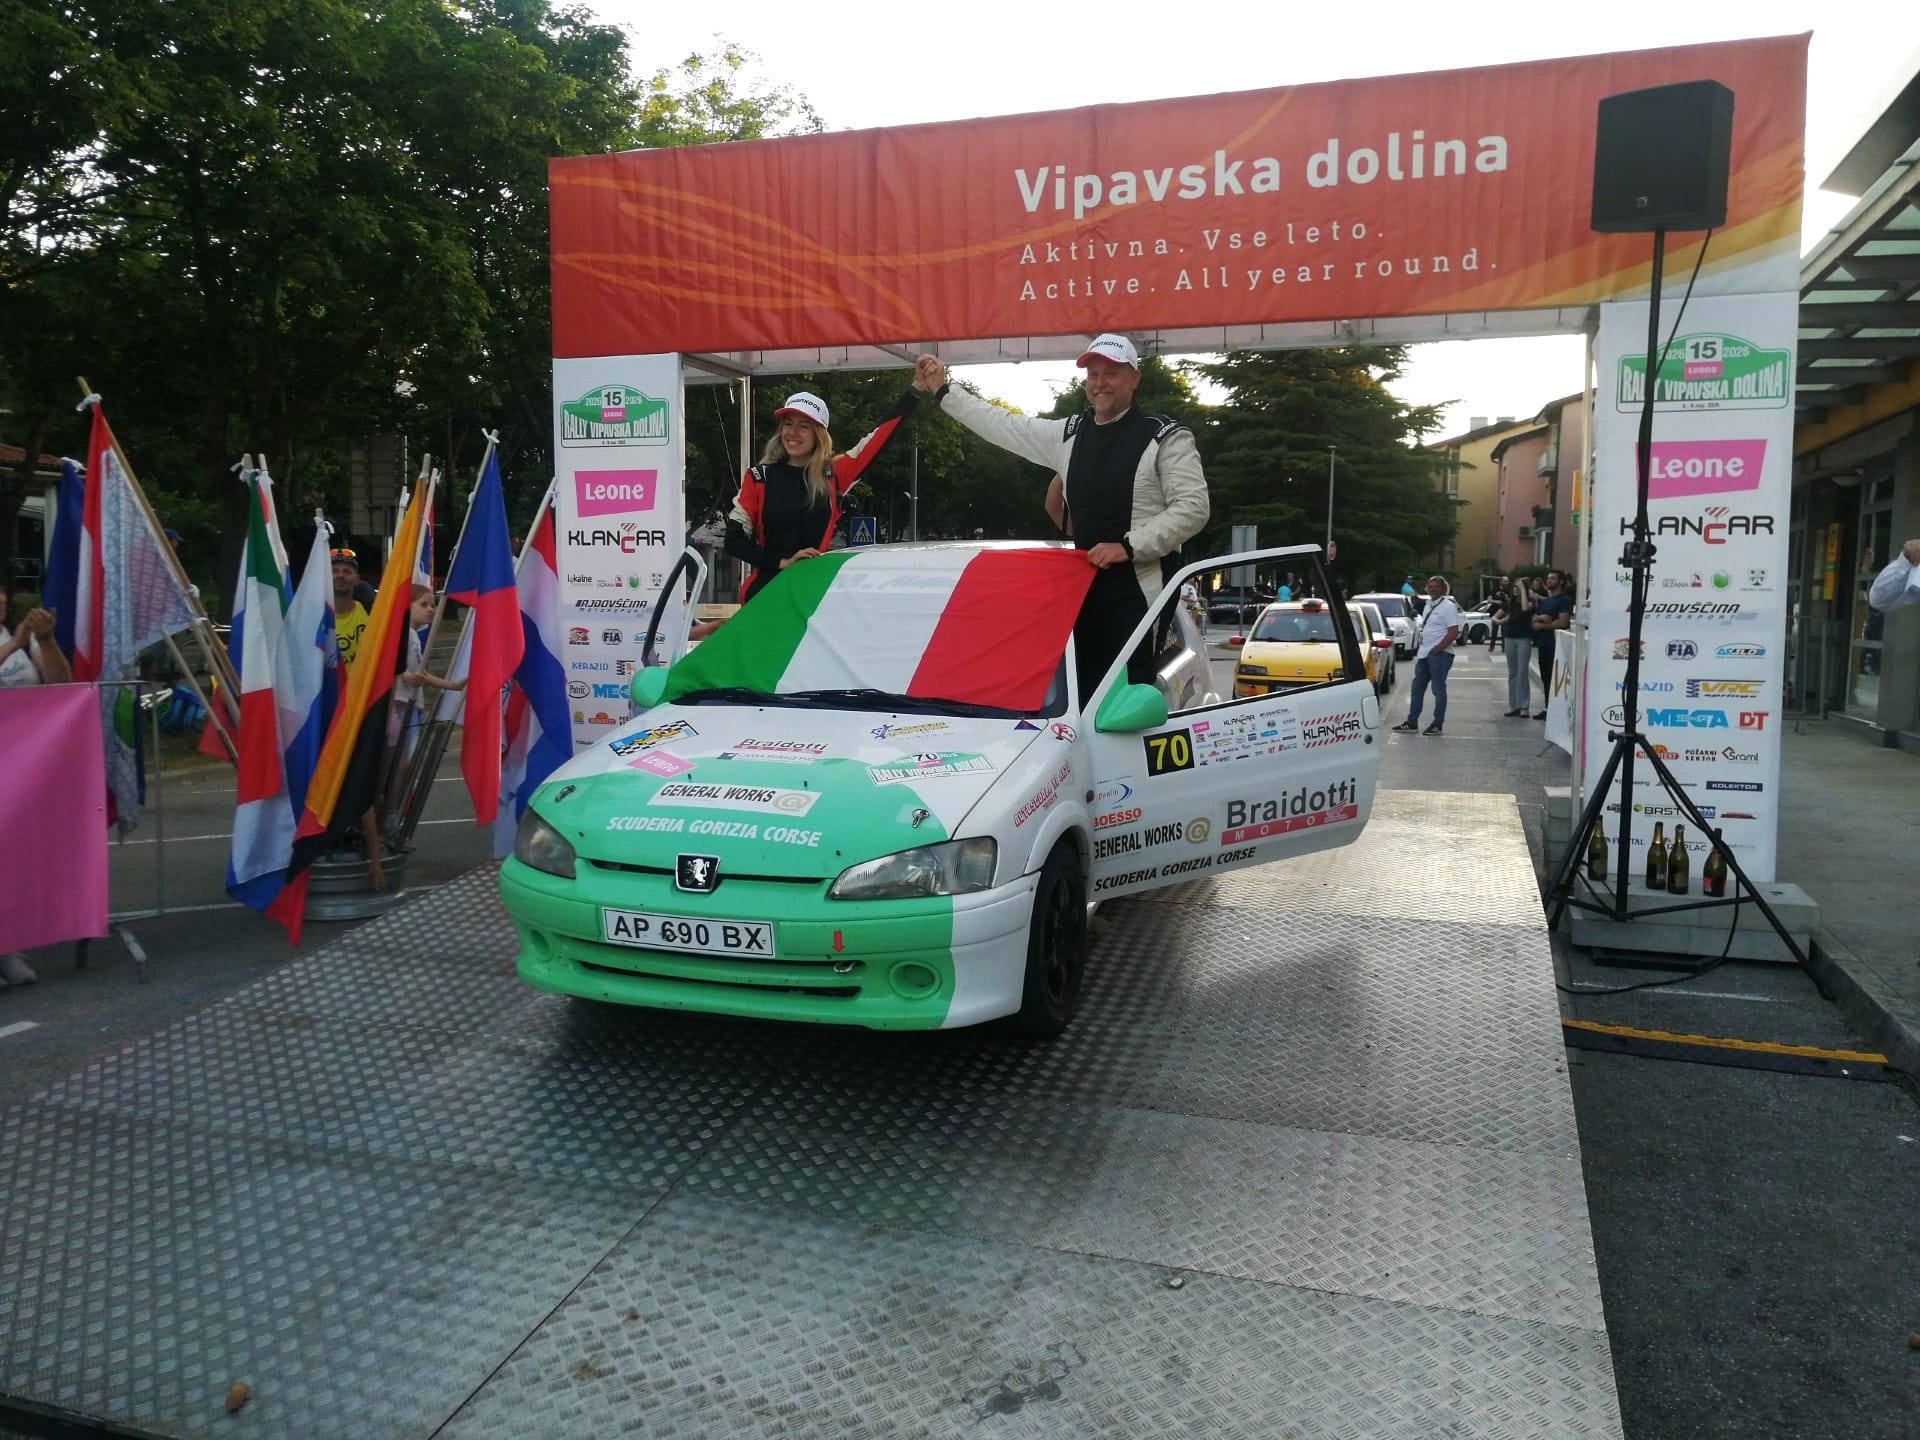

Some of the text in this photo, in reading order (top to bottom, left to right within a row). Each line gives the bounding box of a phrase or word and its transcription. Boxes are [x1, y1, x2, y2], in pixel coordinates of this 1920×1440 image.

[1015, 130, 1508, 220] Vipavska dolina
[1019, 220, 1384, 265] Aktivna. Vse leto.
[1019, 248, 1497, 301] Active. All year round.
[1690, 341, 1717, 360] 15
[1622, 360, 1783, 402] RALY VIPAVSKA DOLINA
[604, 391, 622, 406] 15
[563, 407, 666, 439] RALLY VIPAVSKA DOLINA
[1651, 456, 1744, 480] Leone
[585, 482, 645, 501] Leone
[1643, 601, 1741, 614] JDOVŠČINA
[1615, 681, 1674, 693] KAZID
[1646, 708, 1729, 728] MEGA
[1739, 711, 1769, 730] DT
[739, 738, 828, 751] Braidotti
[1150, 734, 1190, 772] 70
[642, 754, 681, 773] Leone
[912, 752, 938, 762] 70
[871, 767, 905, 783] RALLY
[660, 784, 776, 803] GENERAL WORKS
[1711, 782, 1759, 791] KOLEKTOR
[1226, 776, 1357, 830] Braidotti
[1644, 805, 1681, 816] BRST
[606, 816, 823, 848] SCUDERIA GORIZIA CORSE
[1144, 821, 1183, 848] WORKS
[1094, 846, 1257, 892] SCUDERIA GORIZIA CORSE
[613, 915, 765, 951] AP 690 BX
